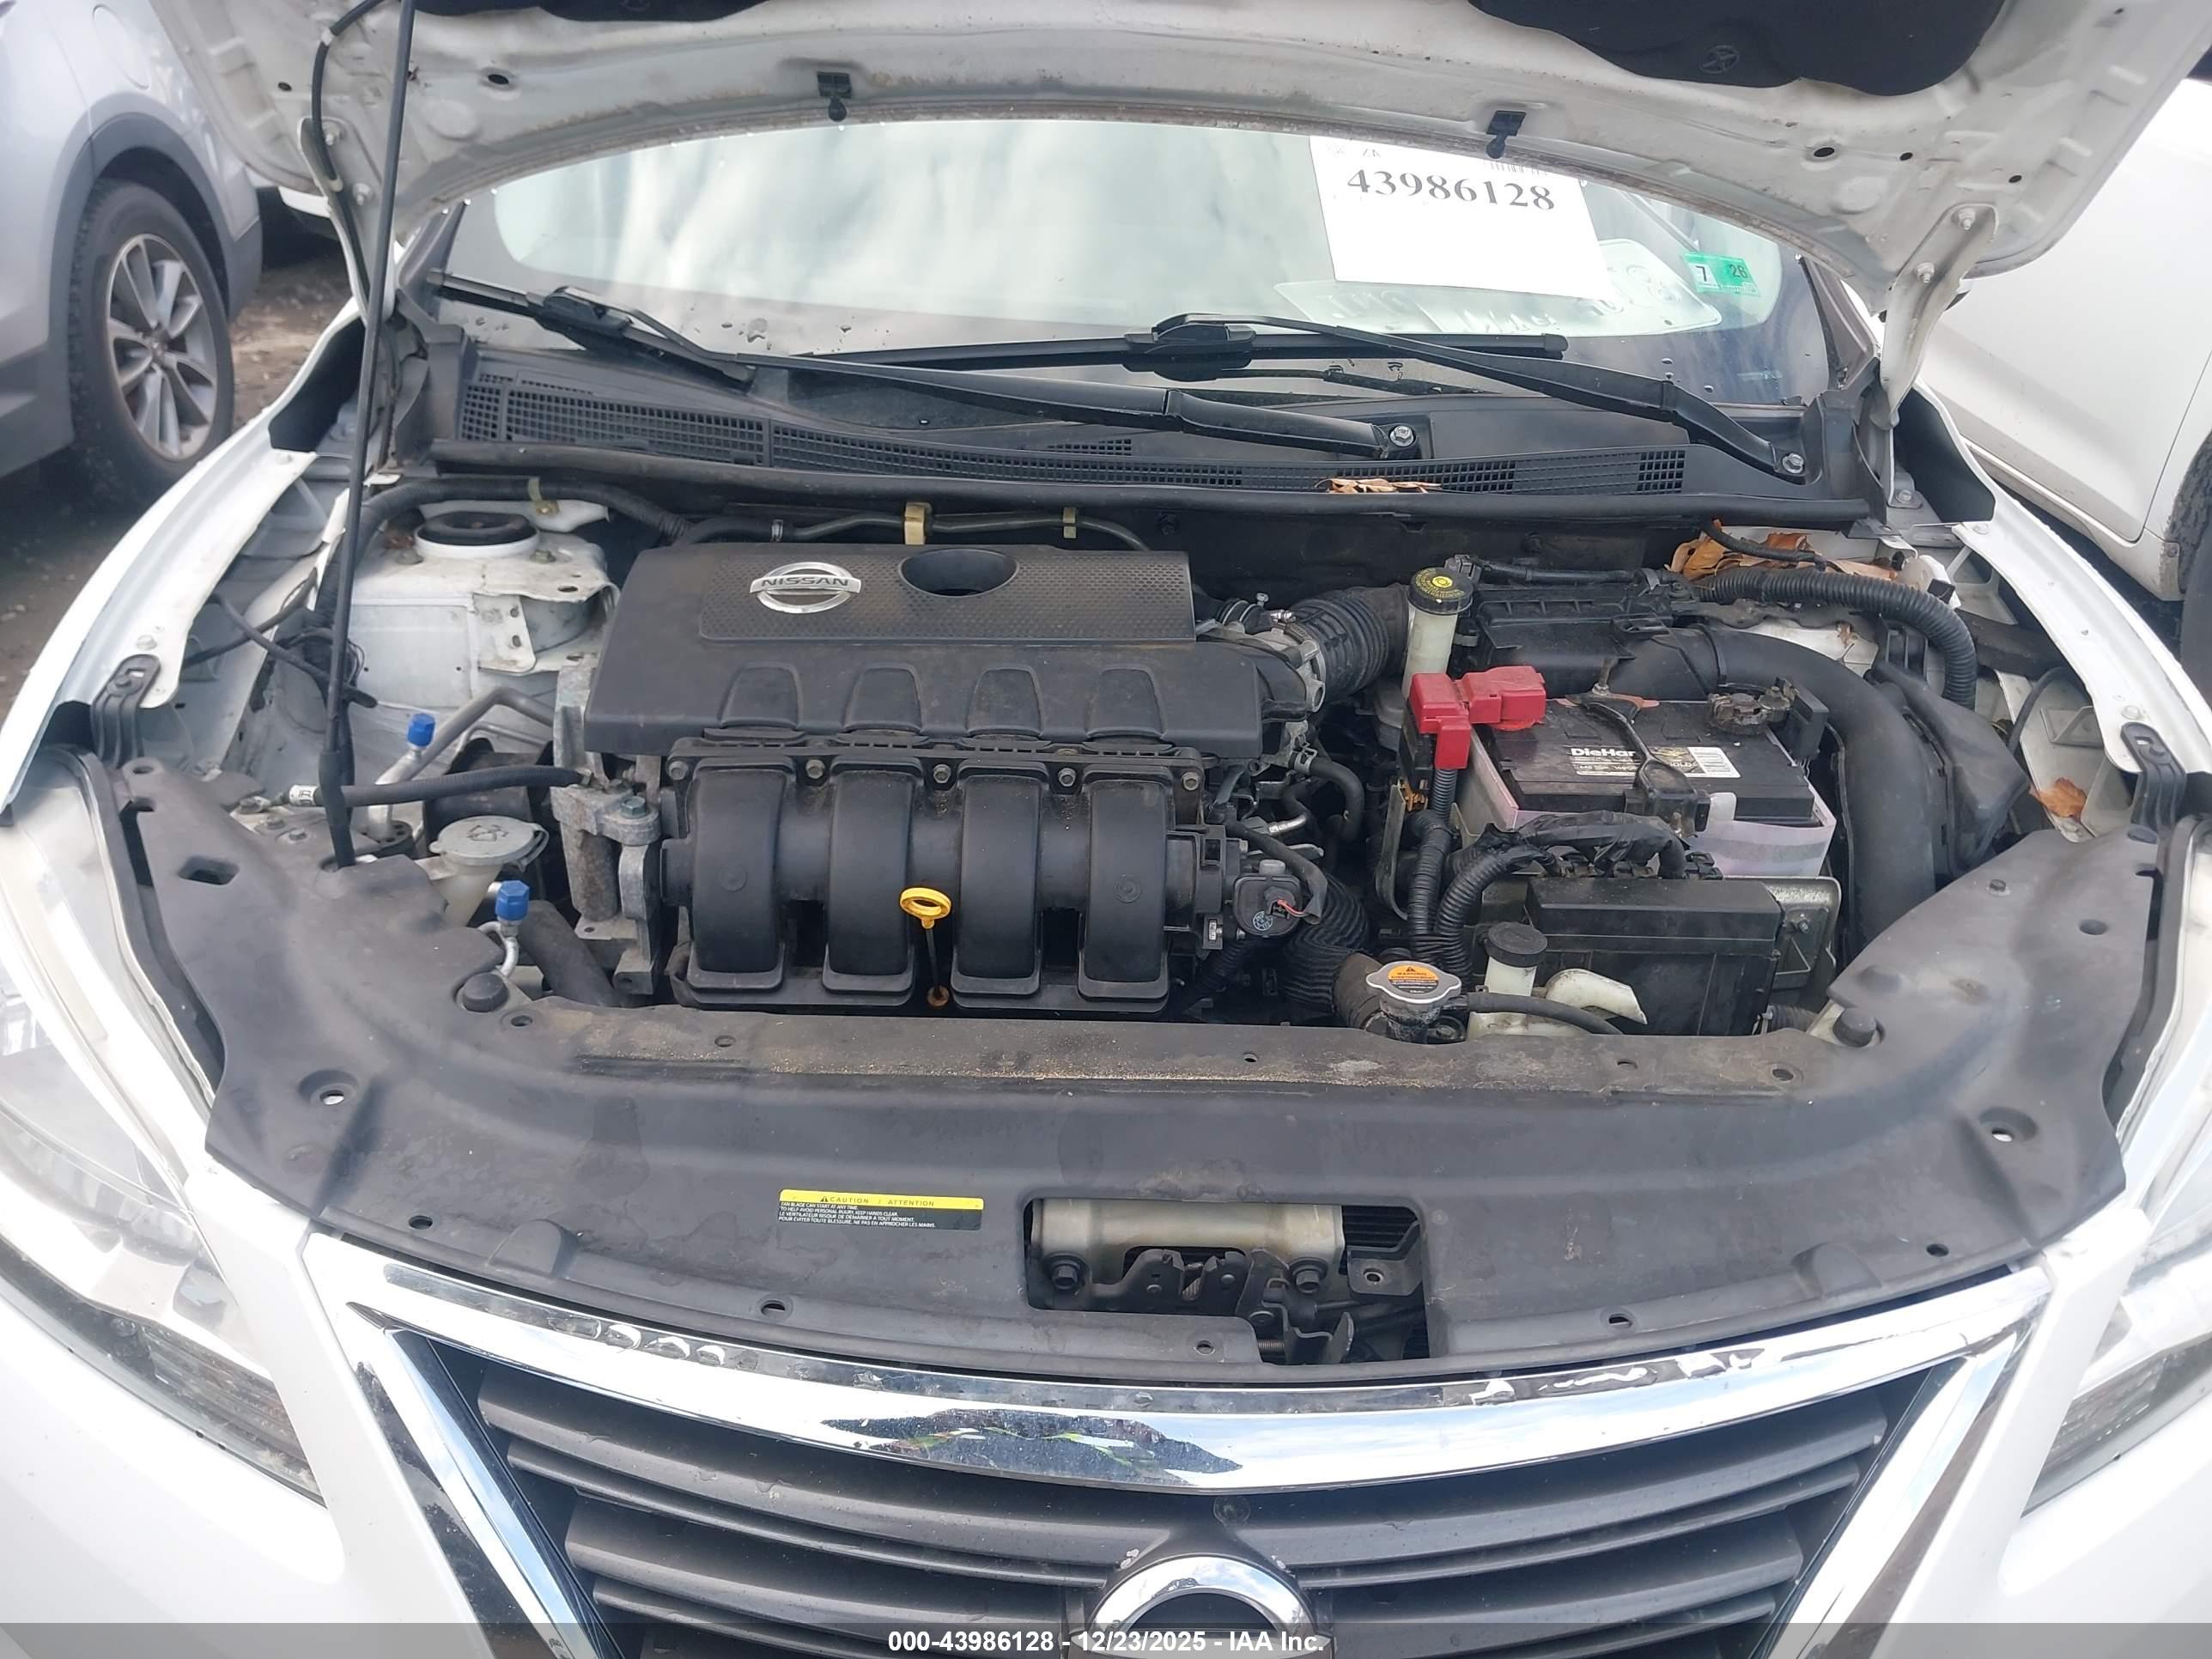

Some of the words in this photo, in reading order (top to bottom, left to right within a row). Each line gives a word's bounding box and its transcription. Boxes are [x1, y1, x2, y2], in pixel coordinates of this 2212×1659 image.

[1346, 168, 1556, 211] 43986128
[1695, 264, 1707, 283] 7
[1729, 264, 1748, 279] 26
[761, 576, 849, 587] NISSAN
[1571, 747, 1637, 757] DieHar
